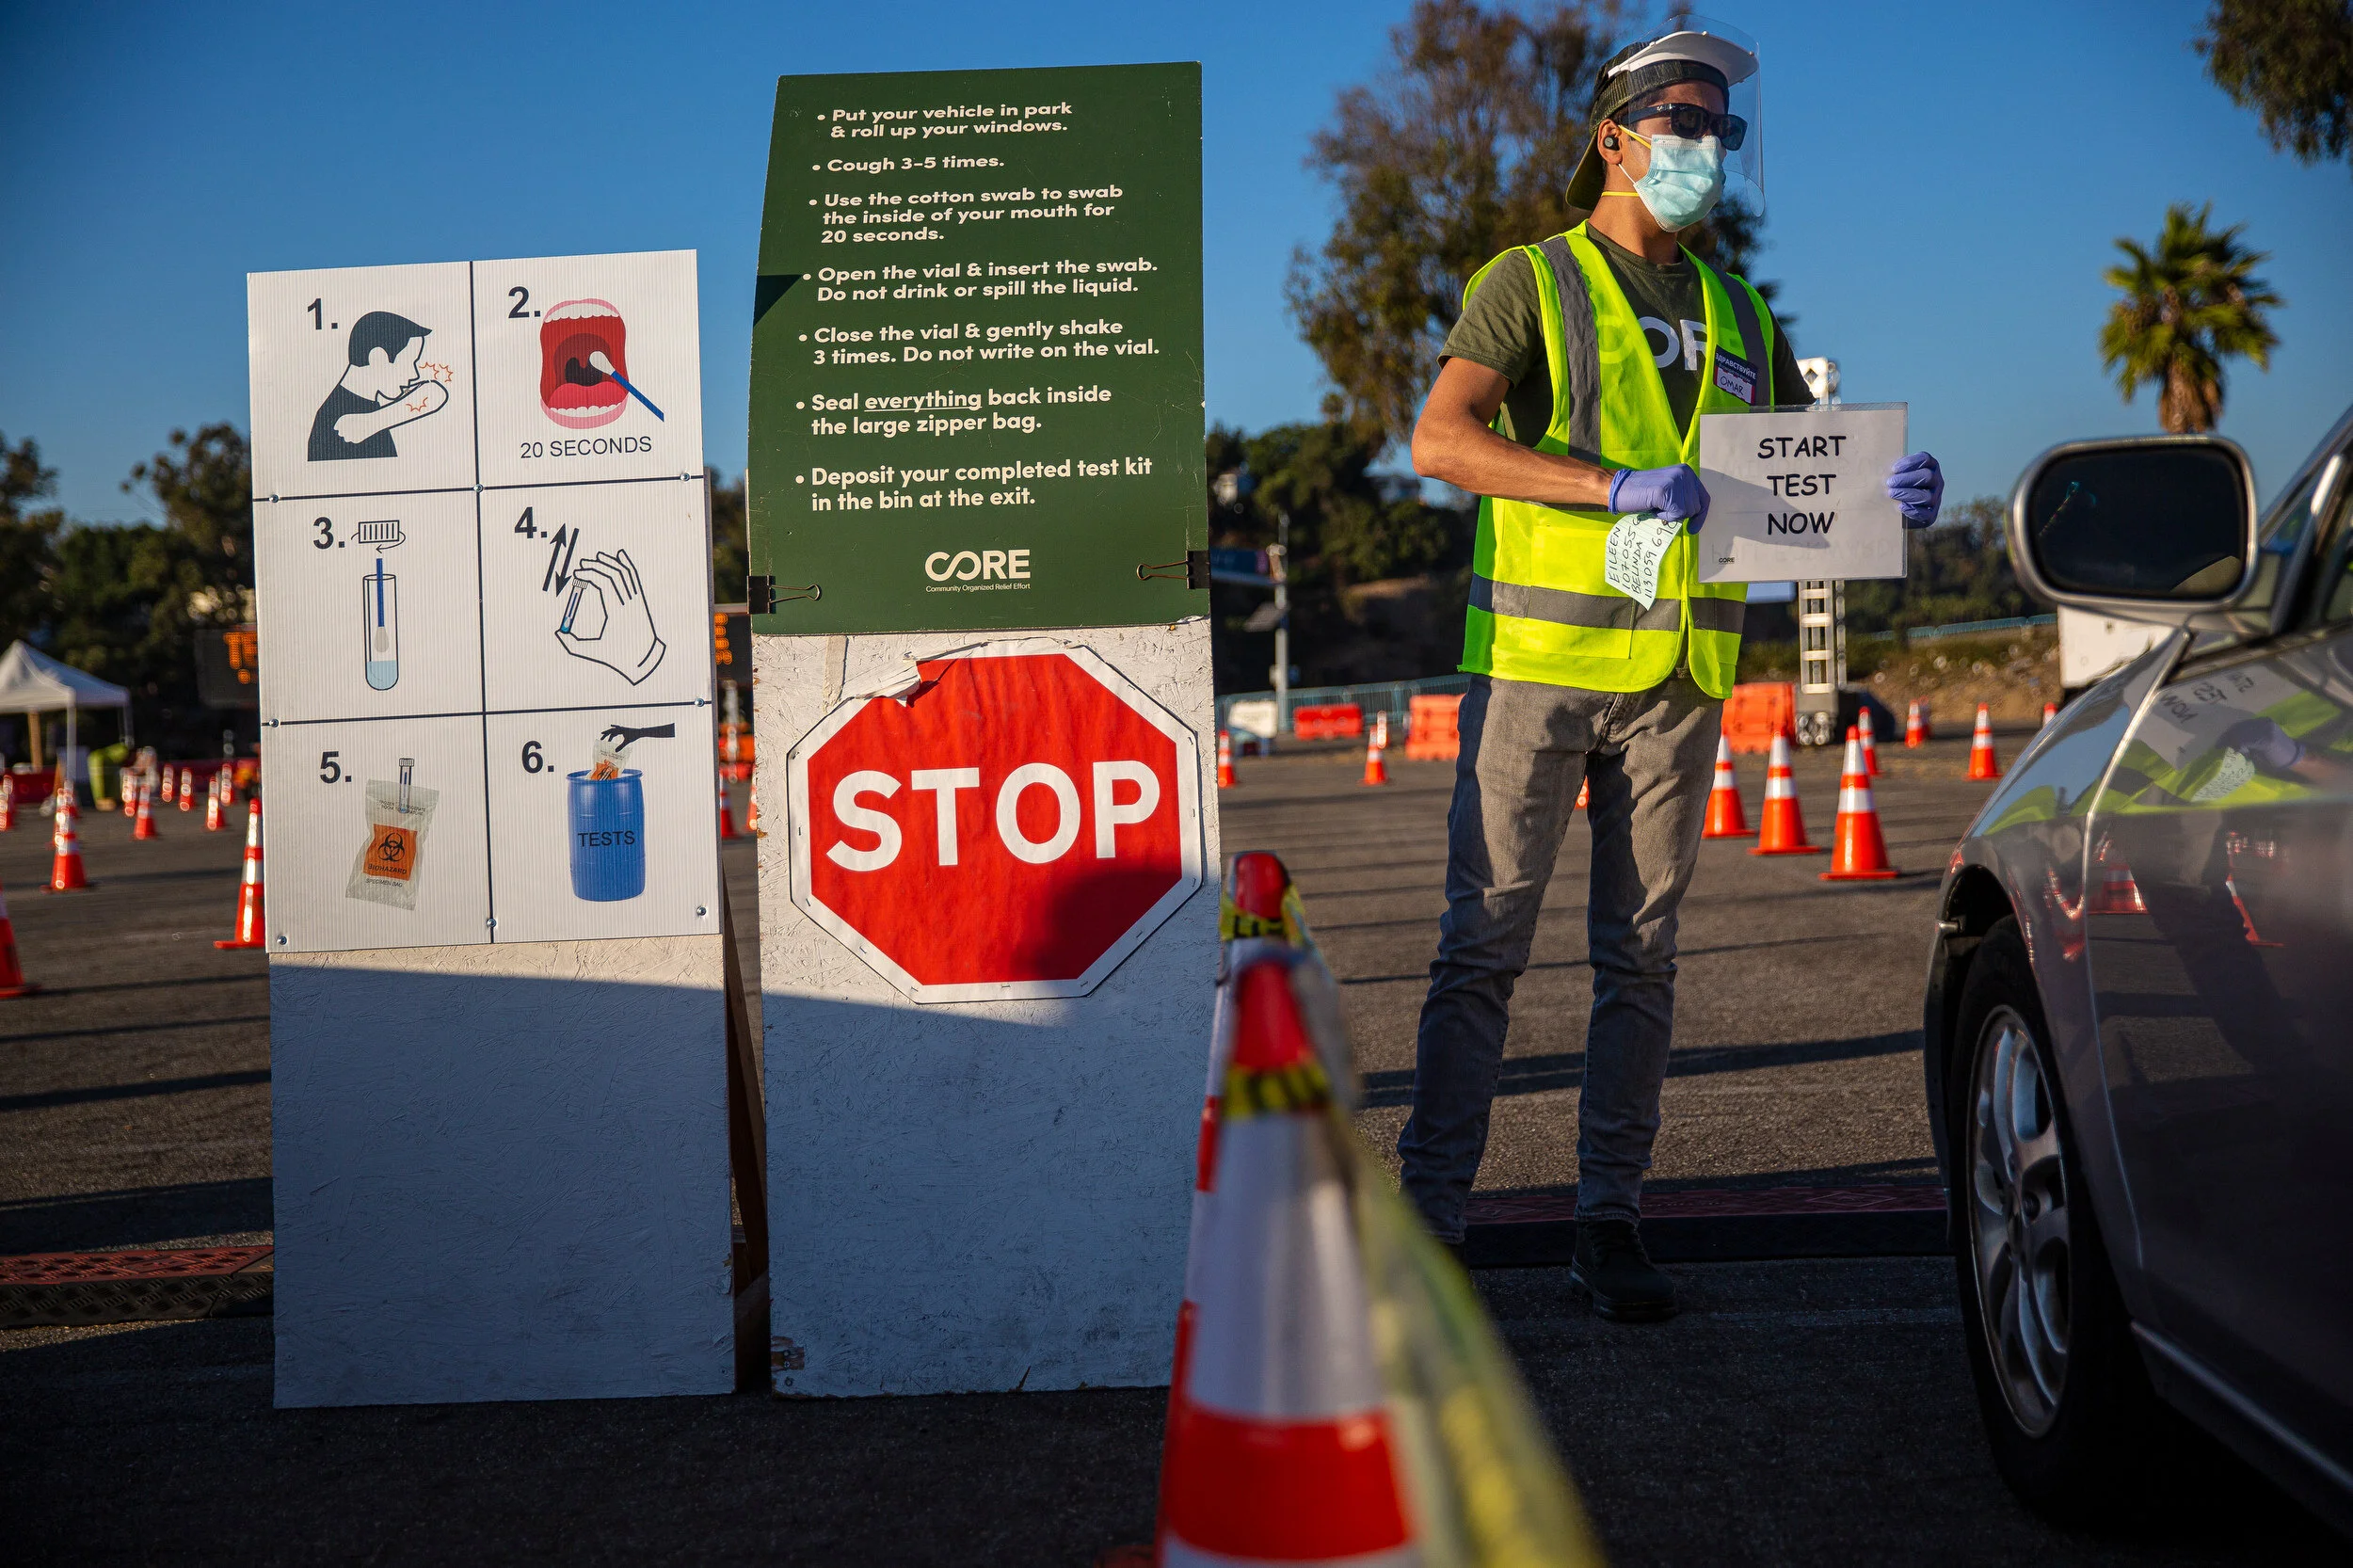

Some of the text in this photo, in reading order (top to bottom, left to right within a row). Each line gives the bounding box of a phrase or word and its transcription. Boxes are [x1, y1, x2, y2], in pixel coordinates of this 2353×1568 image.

[832, 101, 1073, 124] Put your vehicle in park
[830, 119, 1068, 140] & roll up your windows.
[826, 157, 895, 175] Cough
[941, 154, 1005, 168] times.
[824, 184, 1124, 207] Use the cotton swab to swab
[822, 202, 1115, 225] the inside of your mouth for
[821, 226, 945, 244] 20 seconds.
[818, 256, 1159, 286] Open the vial & insert the swab.
[817, 277, 1139, 302] Do not drink or spill the liquid.
[308, 297, 339, 330] 1.
[507, 286, 541, 319] 2.
[813, 318, 1124, 344] Close the vial & gently shake
[812, 338, 1160, 365] 3 times. Do not write on the vial.
[1720, 375, 1744, 396] OMAR
[811, 384, 1112, 413] Seal everything back inside
[810, 411, 1042, 439] the large zipper bag.
[520, 436, 652, 459] 20 SECONDS
[1757, 435, 1847, 459] START
[811, 456, 1153, 490] Deposit your completed test kit
[1766, 473, 1837, 497] TEST
[811, 486, 1036, 512] in the bin at the exit.
[312, 516, 345, 550] 3.
[514, 506, 548, 539] 4.
[1767, 511, 1835, 536] NOW
[924, 549, 1032, 583] CORE
[1609, 526, 1621, 584] EILEEN
[925, 584, 961, 593] Community
[962, 584, 995, 592] Organized
[1013, 582, 1031, 590] Effort
[319, 750, 352, 784] 5.
[521, 740, 554, 774] 6.
[826, 760, 1160, 872] STOP
[577, 830, 635, 847] TESTS
[368, 863, 407, 875] BIOHAZARD
[365, 877, 392, 887] SPECIMEN
